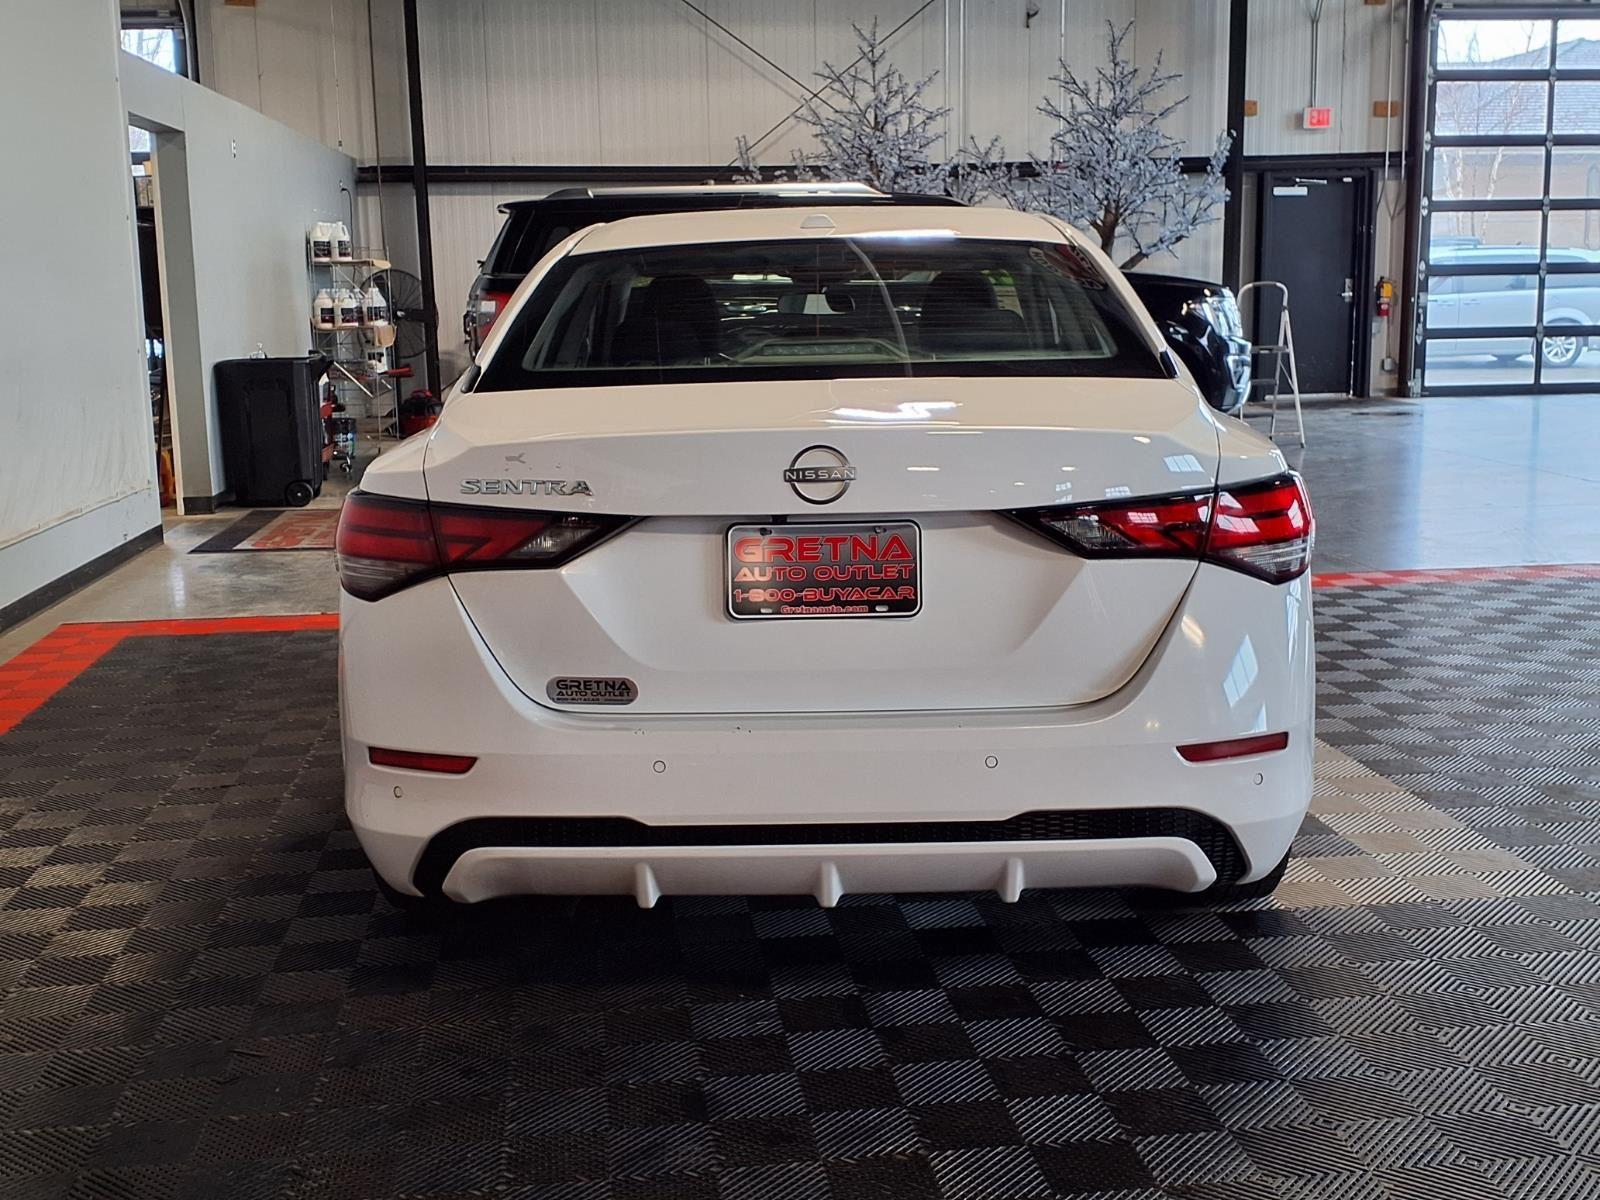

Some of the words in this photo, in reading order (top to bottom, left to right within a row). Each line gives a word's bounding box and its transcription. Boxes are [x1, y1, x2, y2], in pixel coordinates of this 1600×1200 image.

[785, 469, 855, 480] NISSAN
[460, 479, 593, 496] SENTRA
[734, 534, 912, 562] GRETNA
[733, 566, 807, 582] AUTO
[813, 563, 915, 581] OUTLET
[733, 586, 915, 603] 1-800-BUYACAR
[780, 605, 868, 614] Gretnaauto.com
[556, 679, 631, 691] GRETNA
